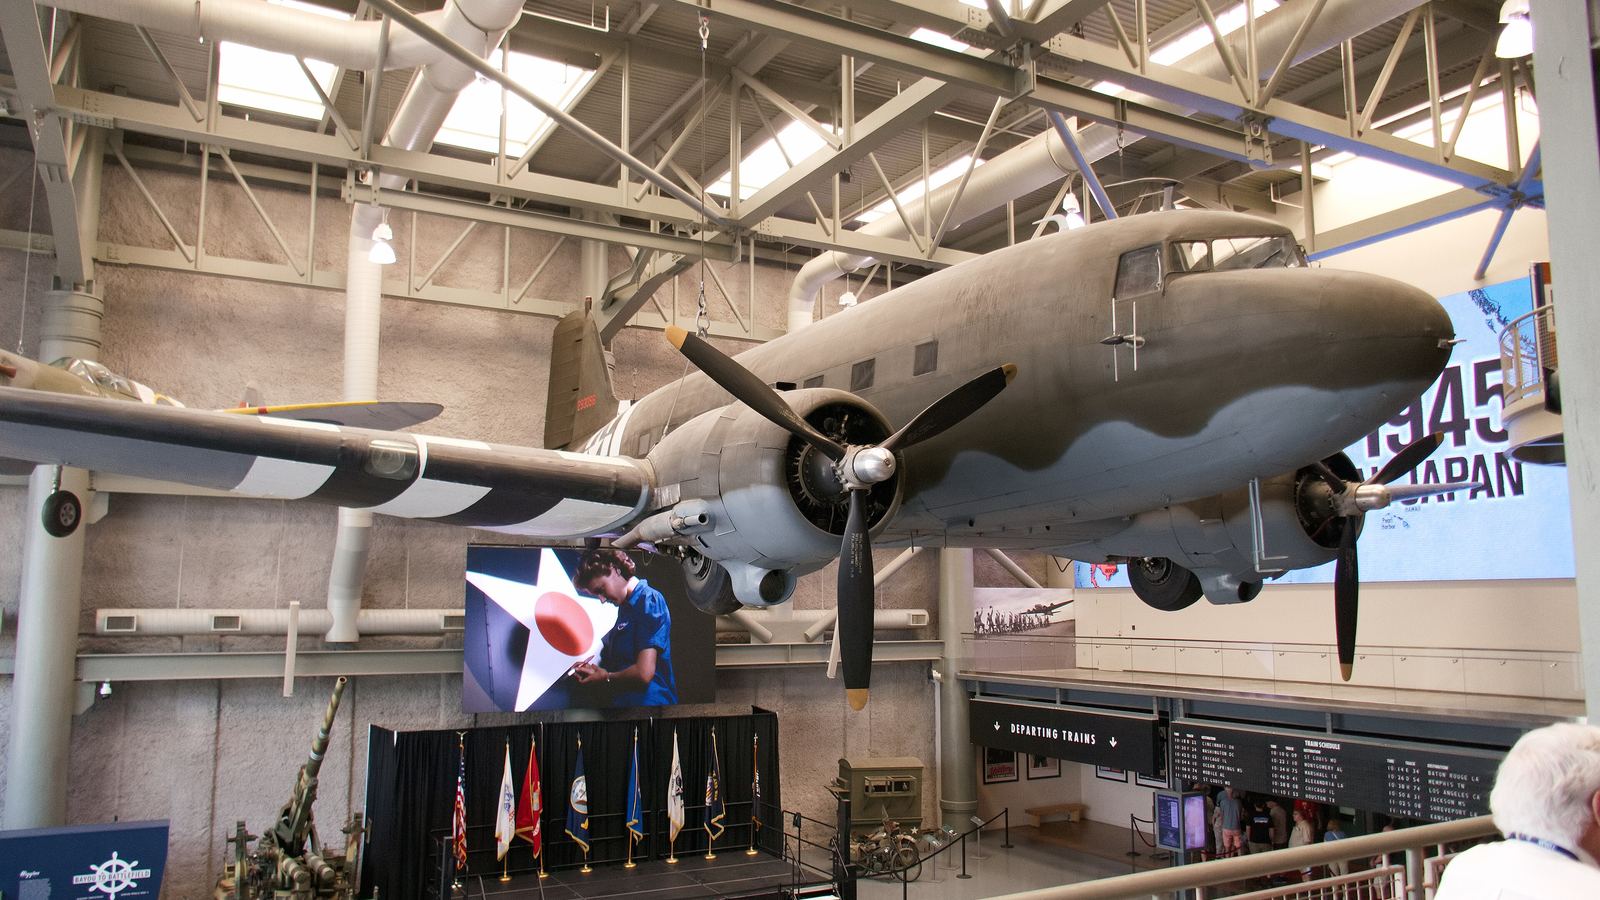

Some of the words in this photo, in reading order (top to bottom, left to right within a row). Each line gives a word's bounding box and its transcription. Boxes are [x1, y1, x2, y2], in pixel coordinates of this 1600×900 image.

[1010, 723, 1058, 739] DEPARTING
[1062, 730, 1096, 745] TRAINS
[1304, 763, 1334, 771] MONTGOMERY
[1305, 778, 1334, 787] ALEXANDRIA
[1443, 790, 1469, 798] ANGELES
[1430, 797, 1455, 805] JACKSON
[1430, 805, 1466, 815] SHREVEPORT
[75, 875, 96, 883] BAYOU
[98, 873, 106, 881] TO
[108, 870, 149, 880] BATTLEFIELD
